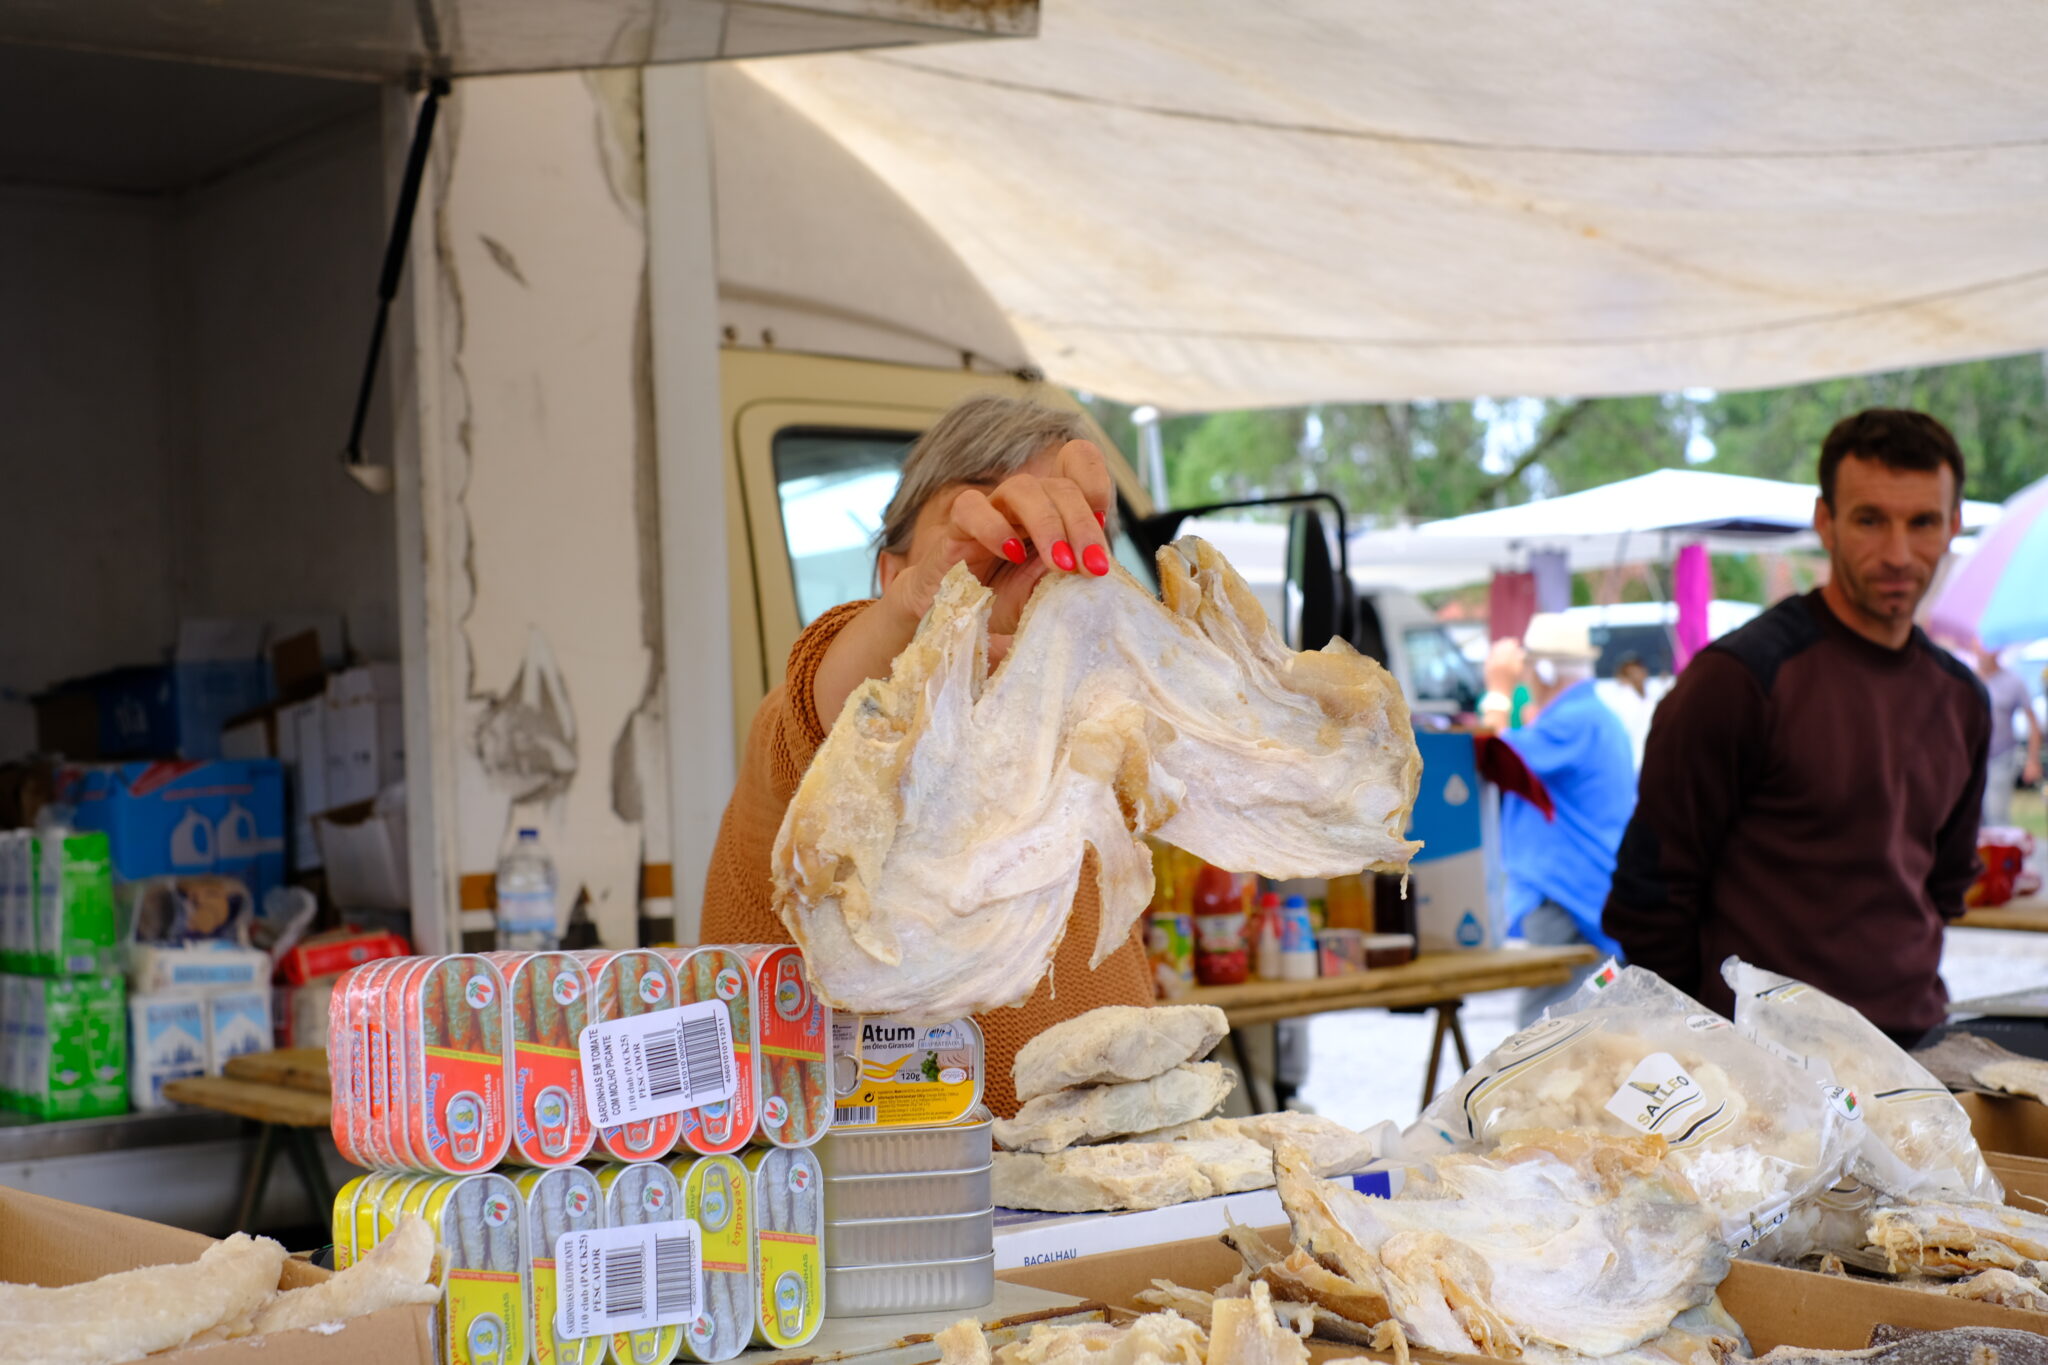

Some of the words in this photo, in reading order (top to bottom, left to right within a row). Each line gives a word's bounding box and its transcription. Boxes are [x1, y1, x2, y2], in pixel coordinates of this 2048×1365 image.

[589, 1029, 600, 1061] TOMATE
[603, 1035, 614, 1068] PICANTE
[862, 1024, 915, 1042] Atum
[872, 1042, 887, 1050] Óleo
[888, 1042, 915, 1050] Girassol
[593, 1063, 601, 1076] EM
[620, 1034, 632, 1076] (PACK25)
[634, 1043, 647, 1099] PESCADOR
[606, 1068, 618, 1096] MOLHO
[626, 1075, 635, 1093] club
[901, 1072, 920, 1082] 120g
[426, 1072, 448, 1151] Pescador
[484, 1074, 494, 1142] SARDINHAS
[515, 1066, 536, 1144] Pescador
[570, 1068, 581, 1136] SARDINHAS
[595, 1077, 608, 1123] SARDINHAS
[609, 1095, 621, 1116] COM
[628, 1093, 637, 1111] 1/10
[730, 1175, 744, 1247] Pescador
[579, 1233, 589, 1288] (PACK25)
[1024, 1248, 1077, 1267] BACALHAU
[592, 1248, 601, 1312] PESCADOR
[761, 1256, 775, 1327] Pescador
[565, 1293, 575, 1334] SARDINHAS
[580, 1289, 589, 1312] club
[535, 1286, 552, 1361] Pescador
[581, 1313, 589, 1334] 1/10
